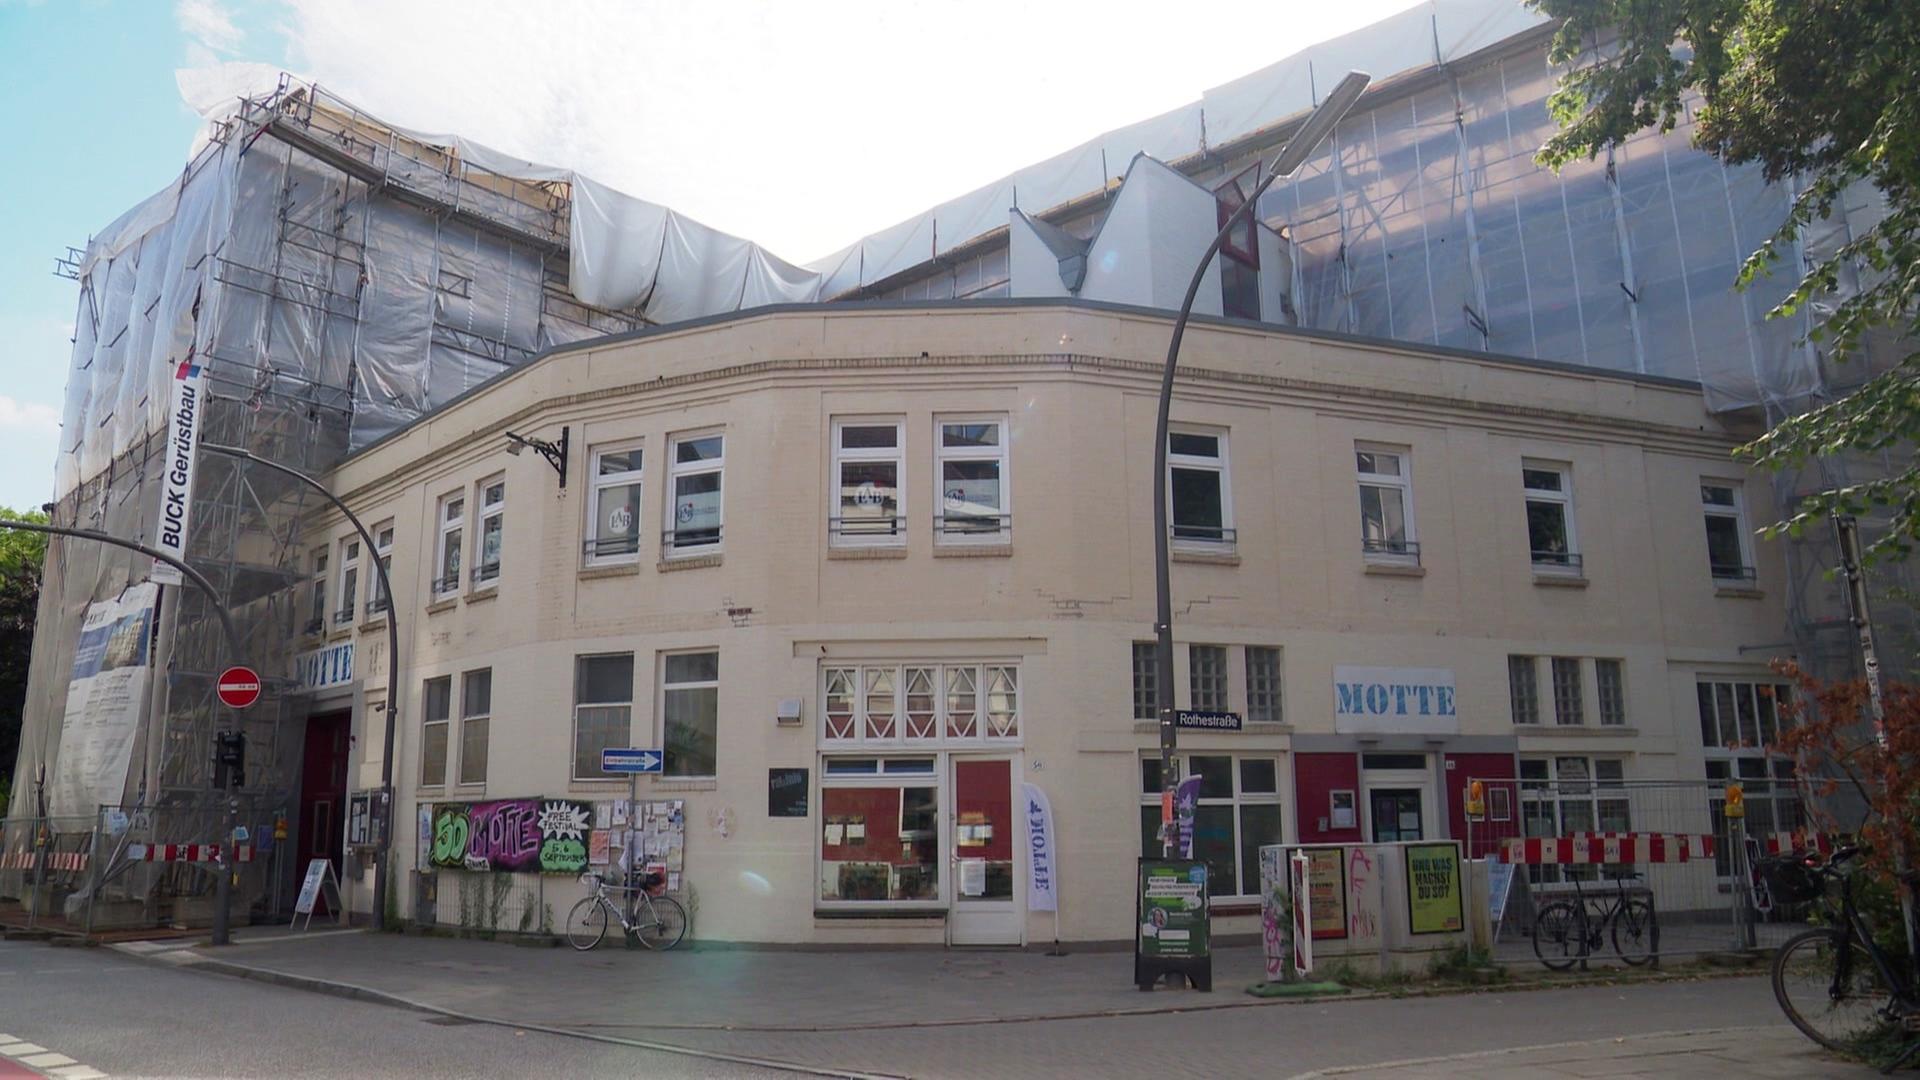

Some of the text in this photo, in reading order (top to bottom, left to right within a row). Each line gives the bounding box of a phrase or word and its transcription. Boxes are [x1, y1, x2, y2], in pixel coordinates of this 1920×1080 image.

[170, 385, 196, 487] Gerüstbau
[858, 487, 882, 504] LAB
[162, 488, 185, 549] BUCK
[610, 511, 631, 529] LAB
[1336, 683, 1456, 716] MOTTE
[1180, 712, 1238, 728] Rothestraße
[548, 812, 572, 822] FREE
[471, 804, 538, 858] MOTTE
[1432, 857, 1453, 871] WAS
[1418, 885, 1431, 899] DU
